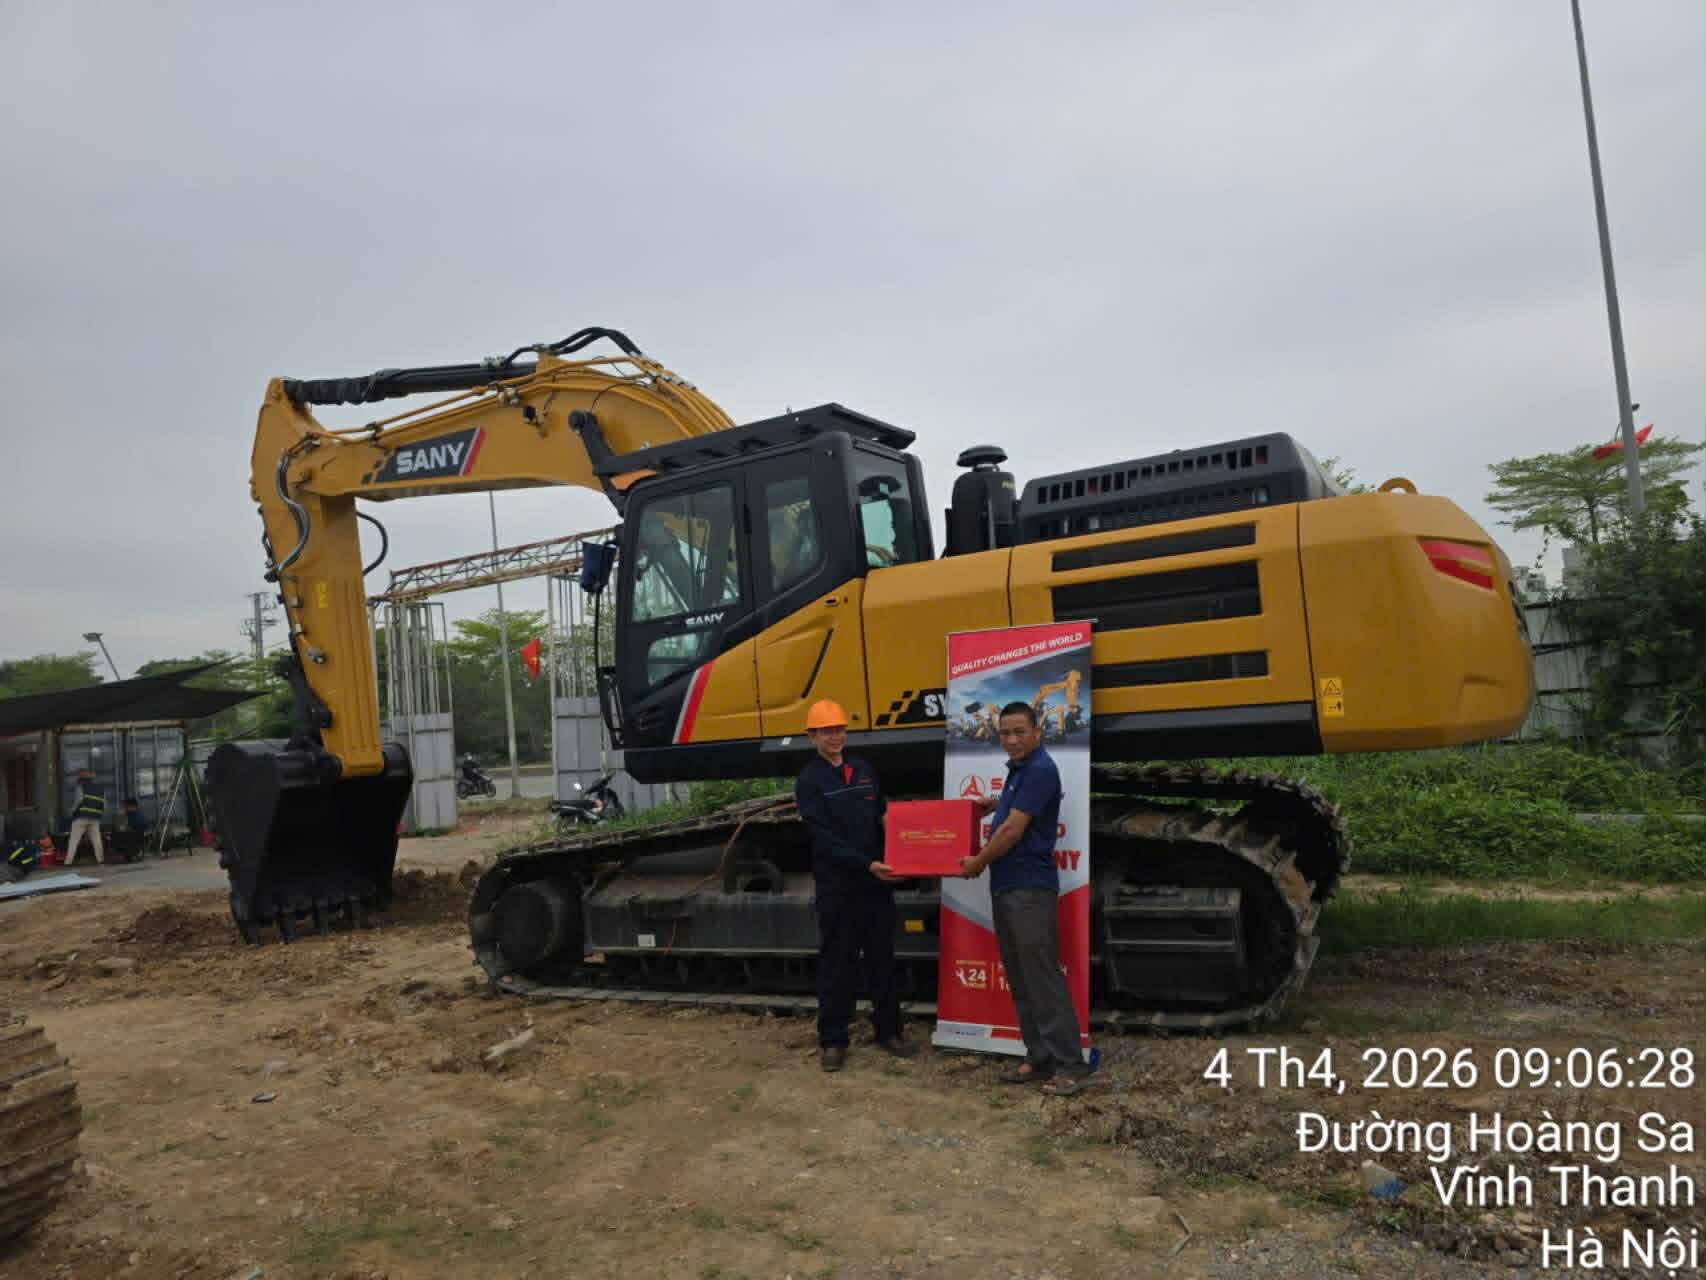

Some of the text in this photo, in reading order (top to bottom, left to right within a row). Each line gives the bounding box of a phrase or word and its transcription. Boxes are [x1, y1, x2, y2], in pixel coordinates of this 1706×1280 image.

[396, 441, 464, 474] SANY
[685, 612, 724, 625] SANY
[951, 632, 1083, 674] QUALITY CHANGES THE WORLD
